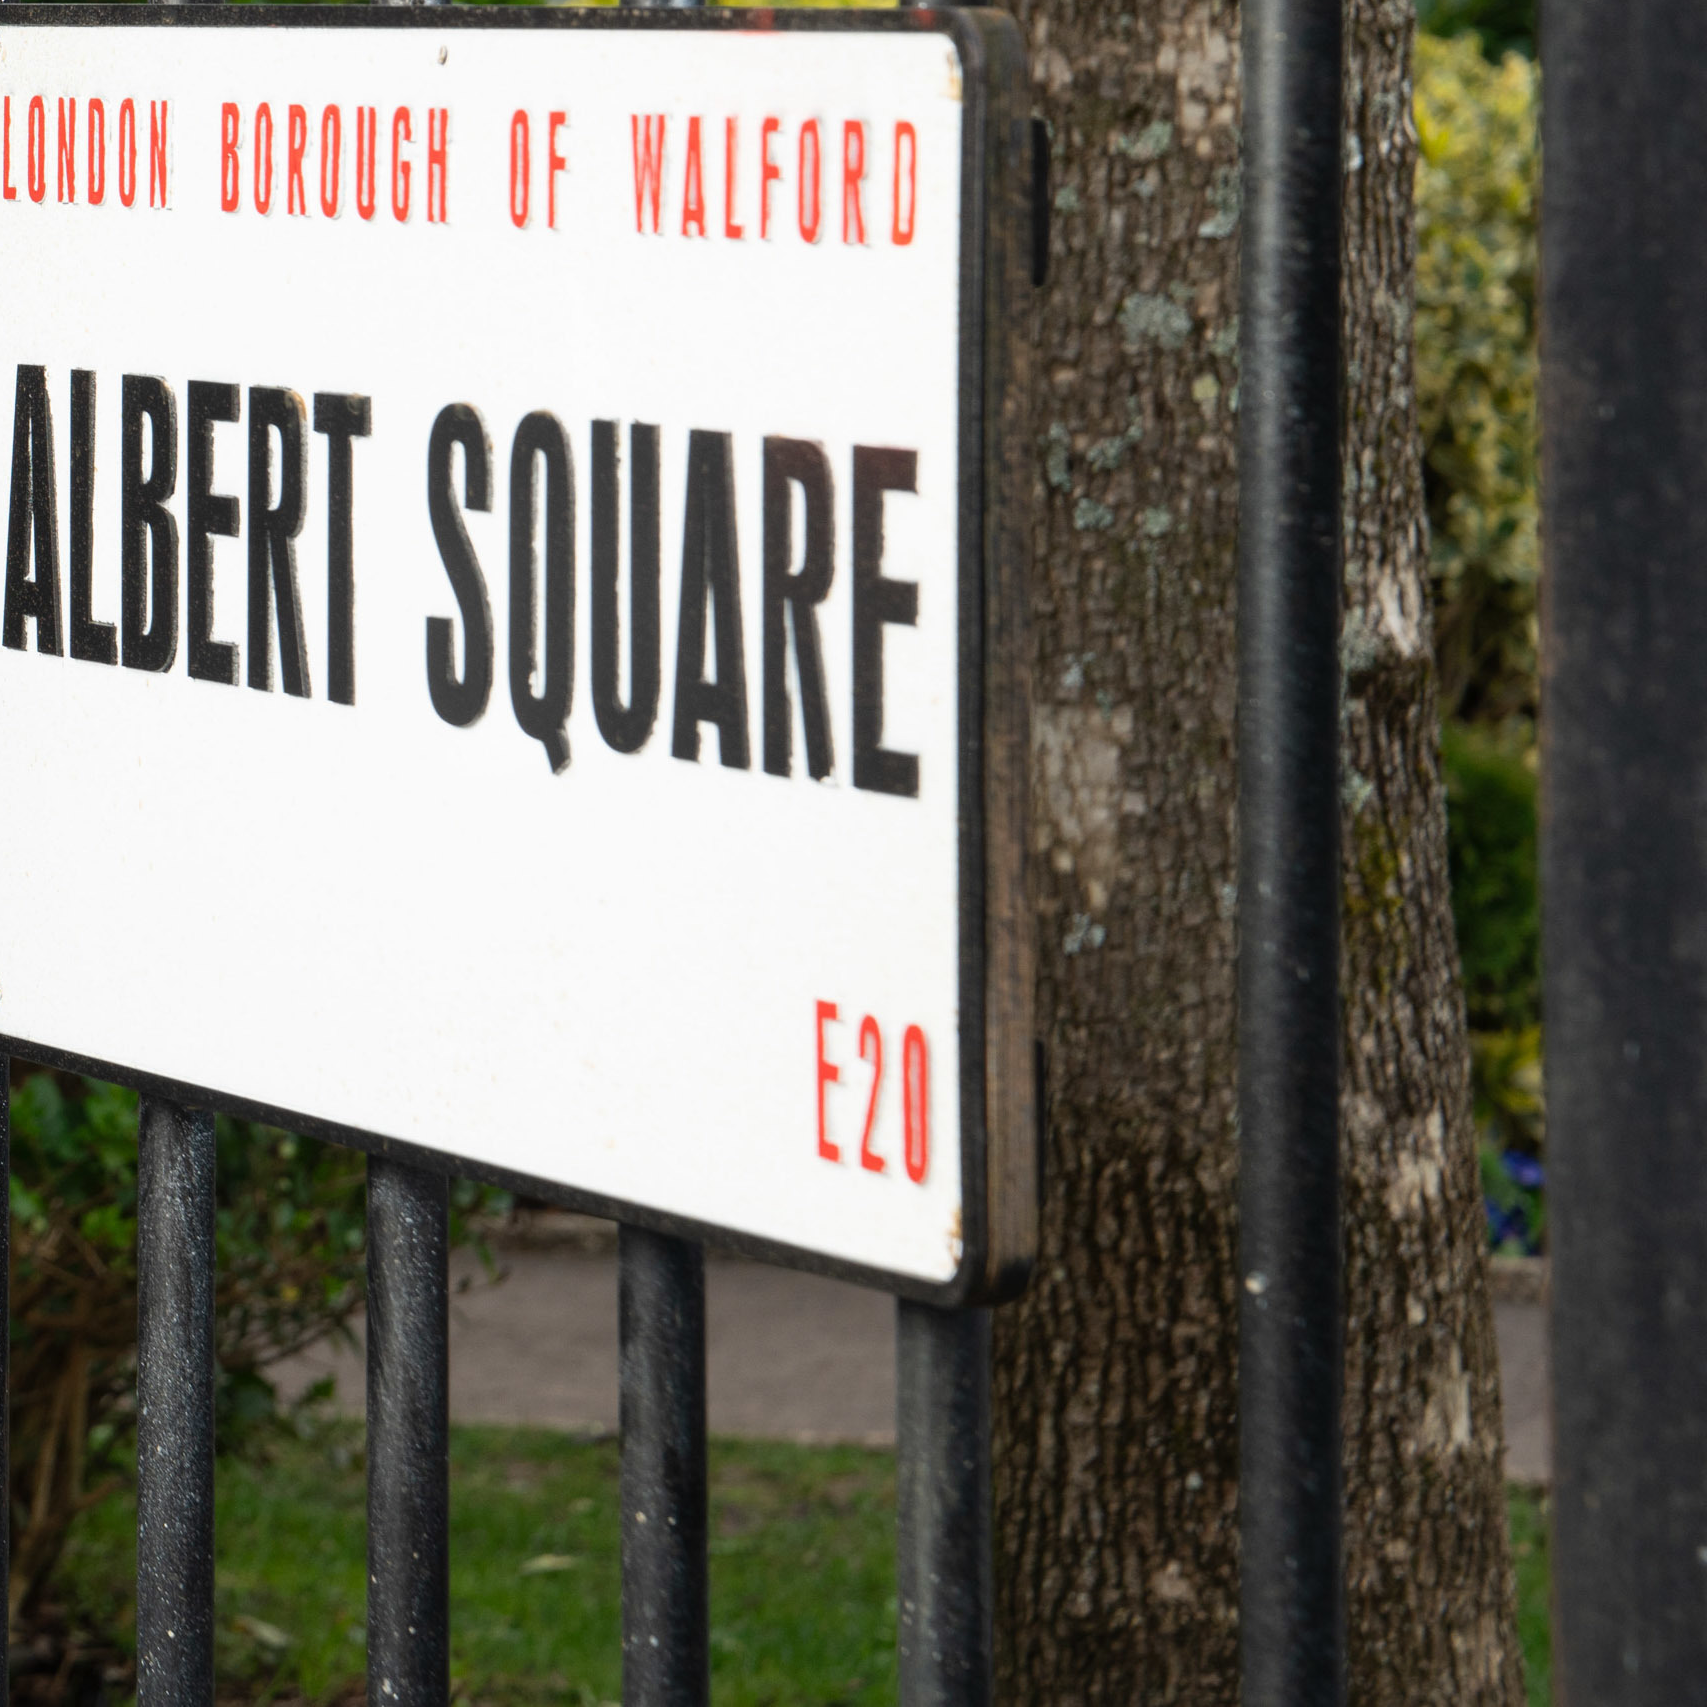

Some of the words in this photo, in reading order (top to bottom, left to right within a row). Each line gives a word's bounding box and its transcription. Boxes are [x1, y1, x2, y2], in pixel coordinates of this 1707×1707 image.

[1, 94, 171, 210] LONDON
[219, 101, 450, 225] BOROUGH
[508, 108, 568, 230] OF
[630, 113, 917, 247] WALFORD
[2, 364, 371, 705] ALBERT
[426, 403, 919, 798] SQUARE
[815, 998, 930, 1185] E20
